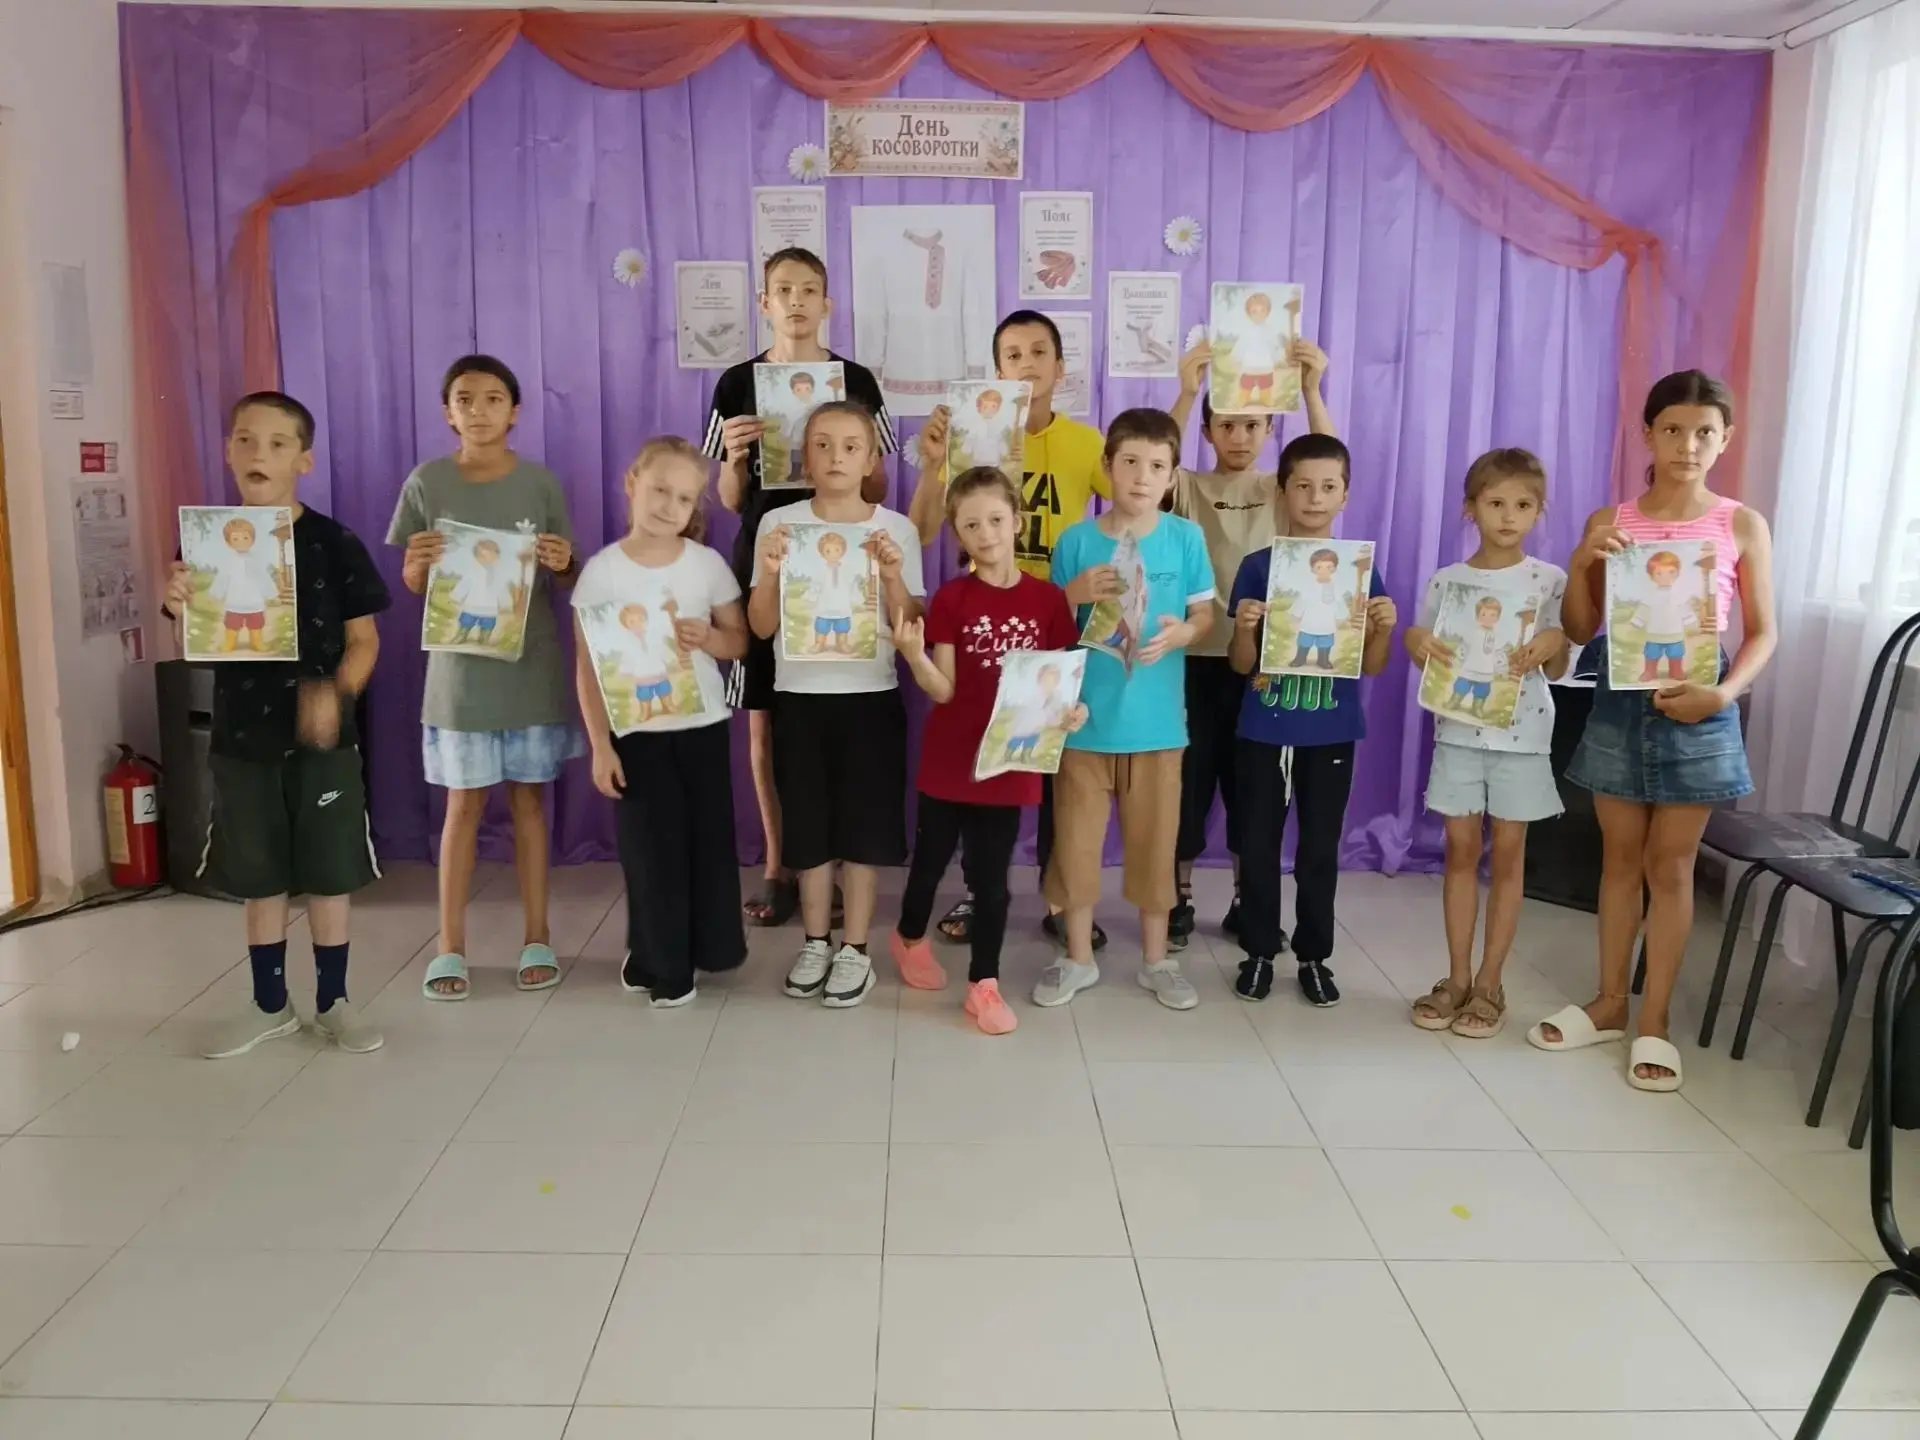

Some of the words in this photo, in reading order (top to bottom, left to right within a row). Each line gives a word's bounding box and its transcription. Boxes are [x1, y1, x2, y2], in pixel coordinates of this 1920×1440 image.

[898, 114, 949, 138] День
[975, 632, 1034, 653] Cute
[144, 793, 156, 815] 2
